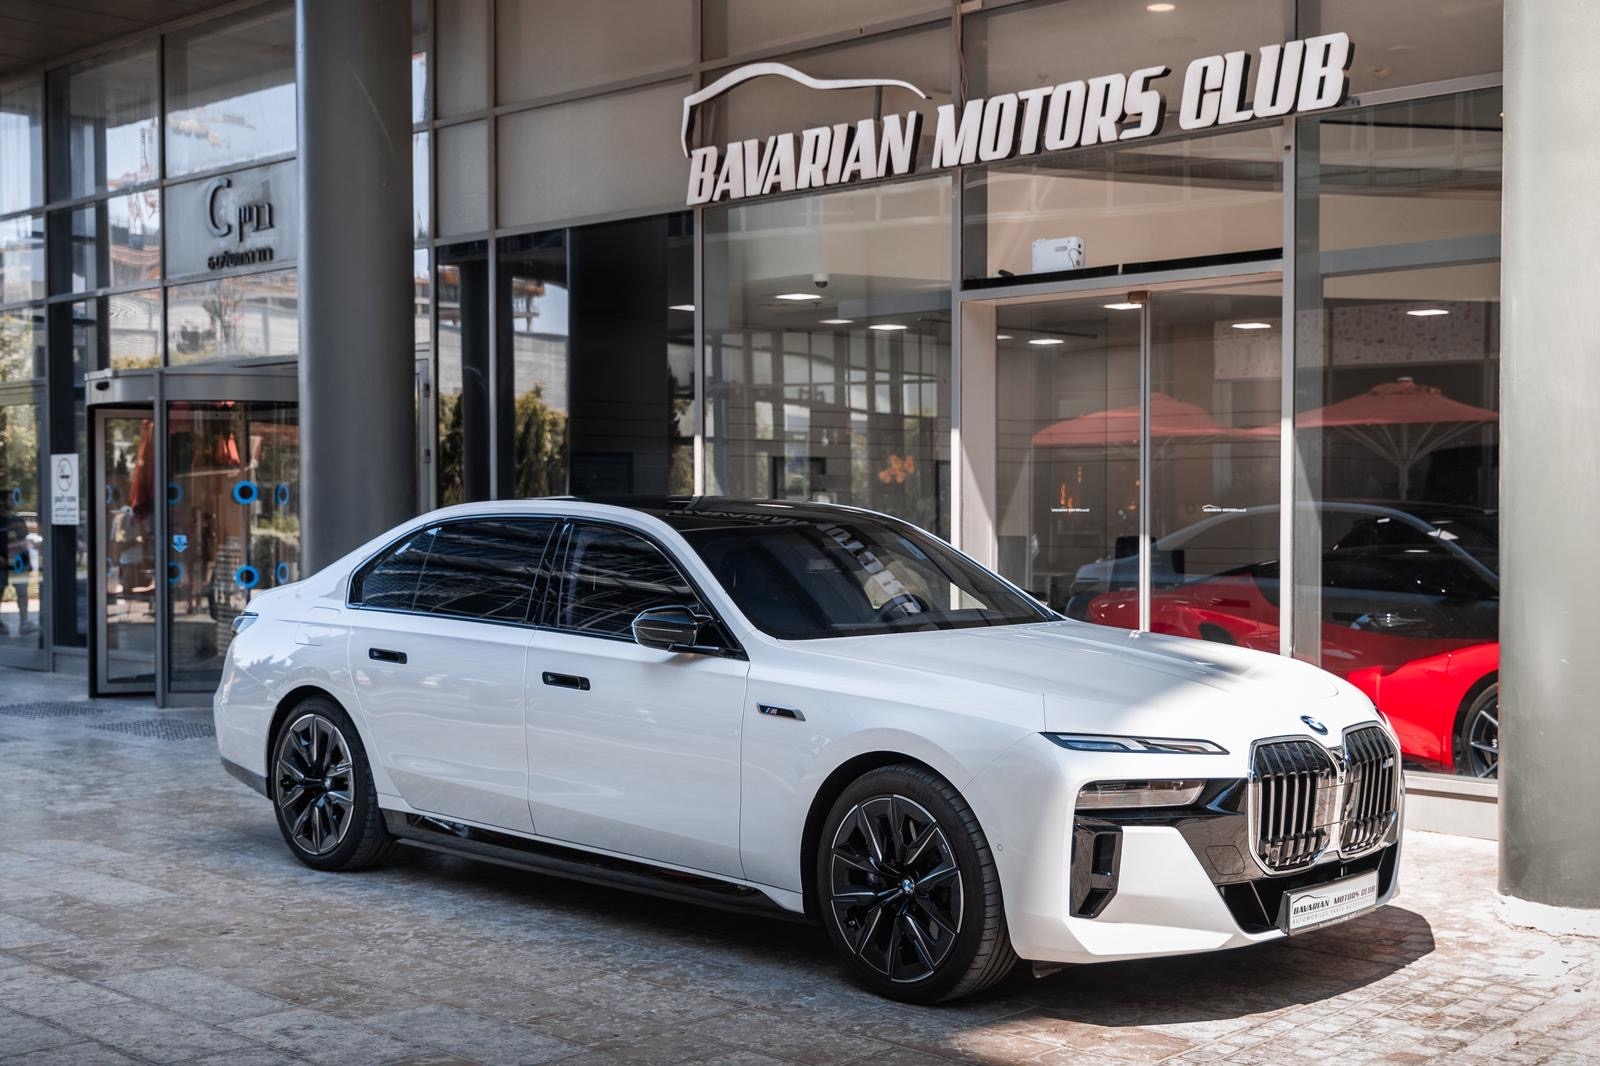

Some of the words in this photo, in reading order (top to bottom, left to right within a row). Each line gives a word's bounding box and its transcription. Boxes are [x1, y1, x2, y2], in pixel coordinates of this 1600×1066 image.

[686, 110, 919, 206] BAVARIAN
[931, 65, 1168, 169] MOTORS
[1178, 31, 1351, 131] CLUB
[1293, 899, 1330, 915] BAVARIAN
[1333, 892, 1359, 905] MOTORS
